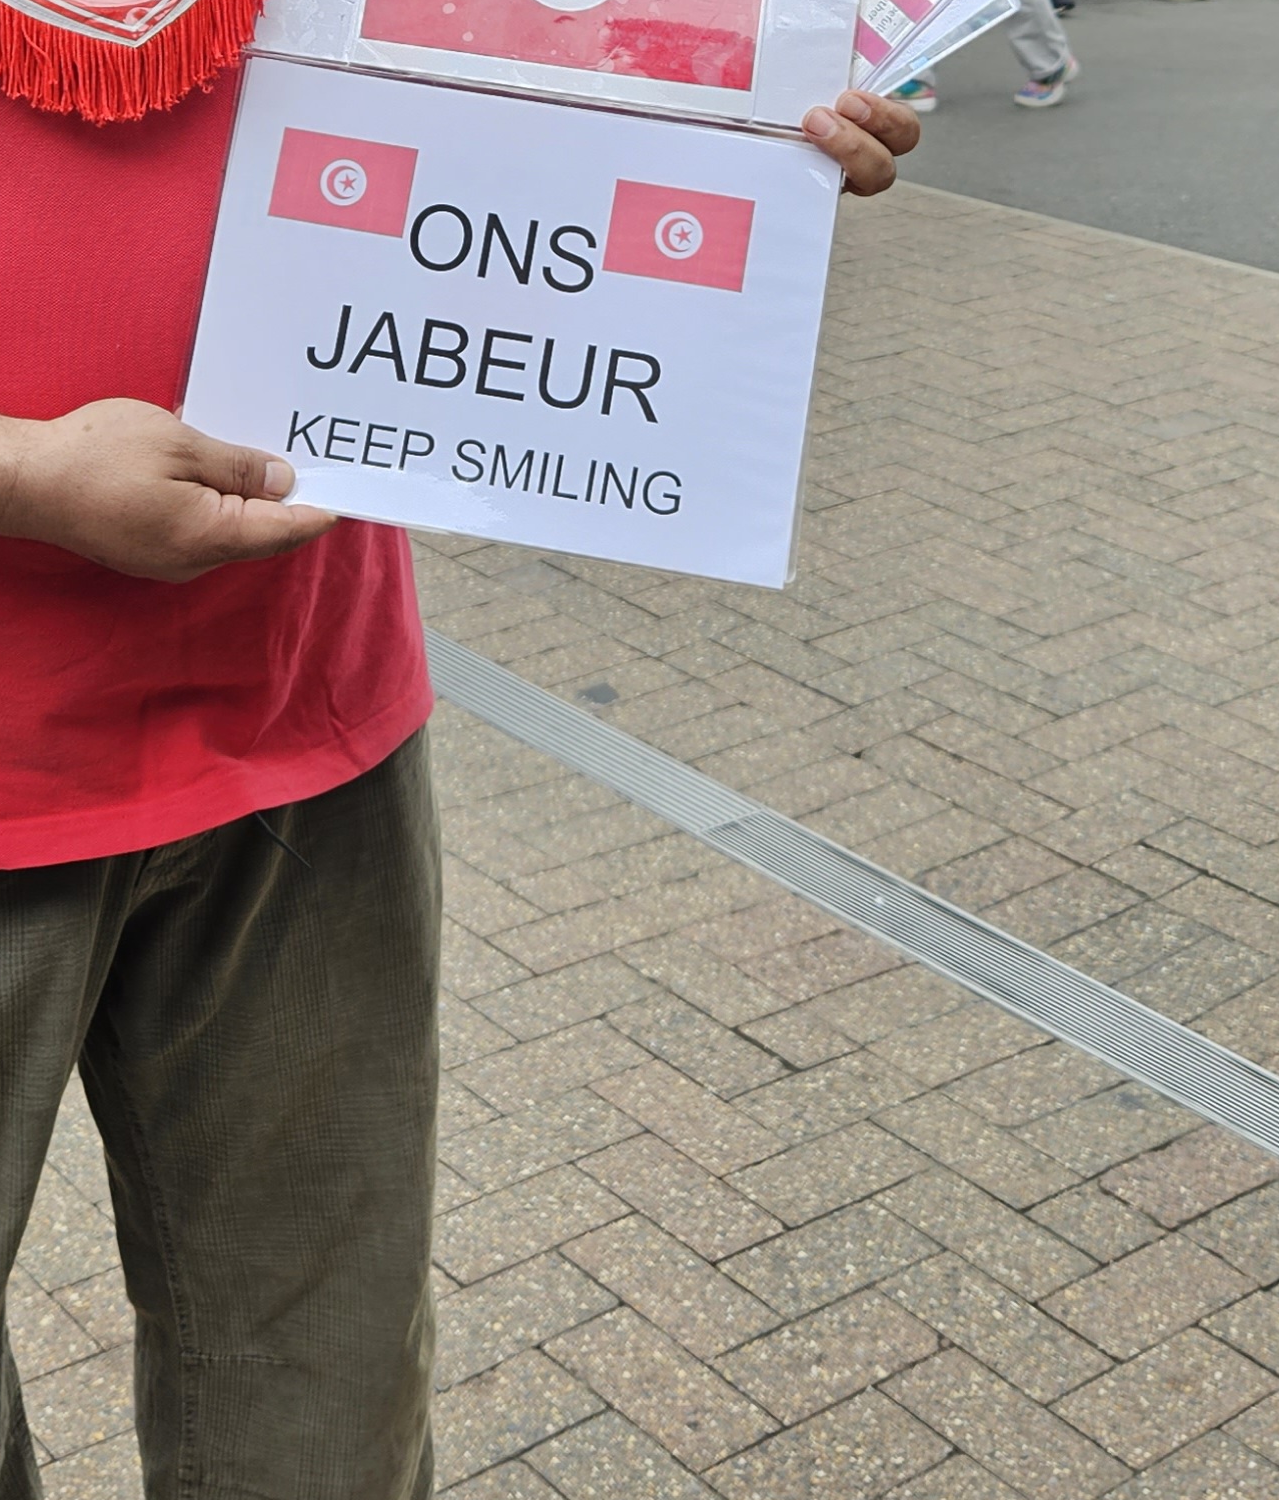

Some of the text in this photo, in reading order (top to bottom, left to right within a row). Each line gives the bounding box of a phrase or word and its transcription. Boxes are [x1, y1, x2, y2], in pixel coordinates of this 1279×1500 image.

[410, 203, 598, 293] ONS
[307, 304, 662, 425] JABEUR
[285, 410, 684, 517] KEEP SMILING
